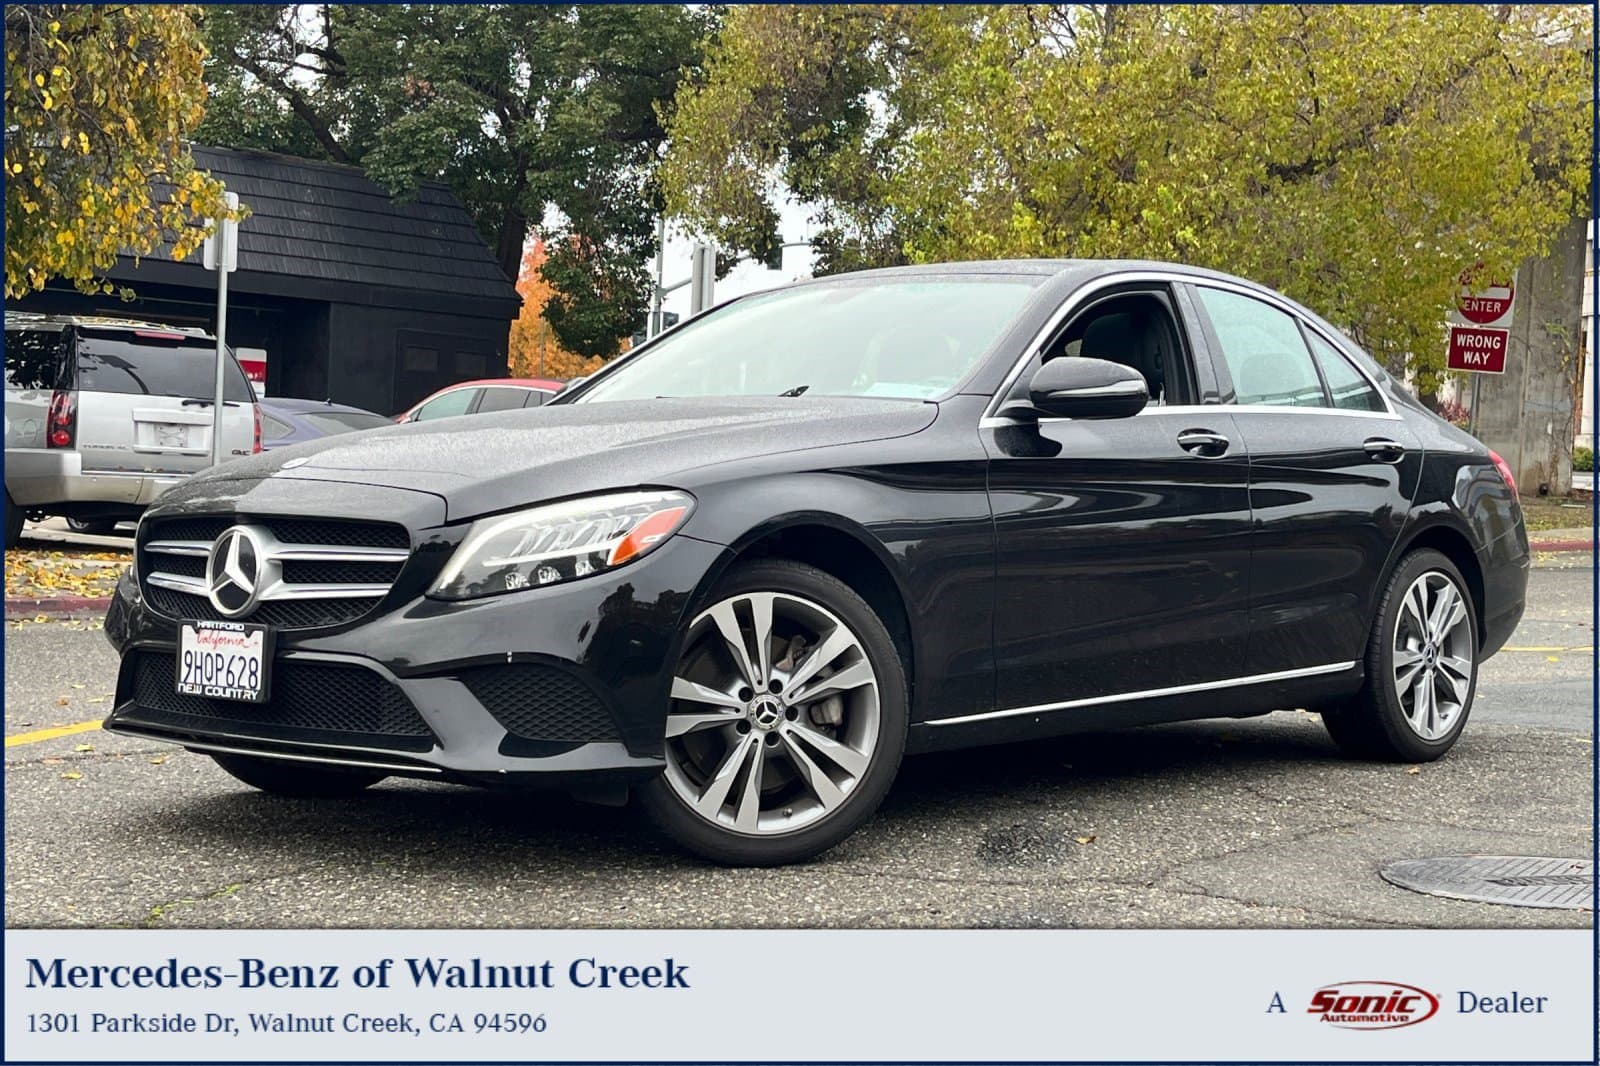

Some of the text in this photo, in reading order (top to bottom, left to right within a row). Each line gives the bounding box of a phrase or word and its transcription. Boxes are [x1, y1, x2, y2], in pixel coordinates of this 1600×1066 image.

[1464, 300, 1501, 313] ENTER
[1456, 333, 1501, 349] WRONG
[1463, 351, 1490, 366] WAY
[197, 620, 245, 631] HARTFORD
[197, 629, 250, 650] California
[177, 682, 258, 700] NEW COUNTRY
